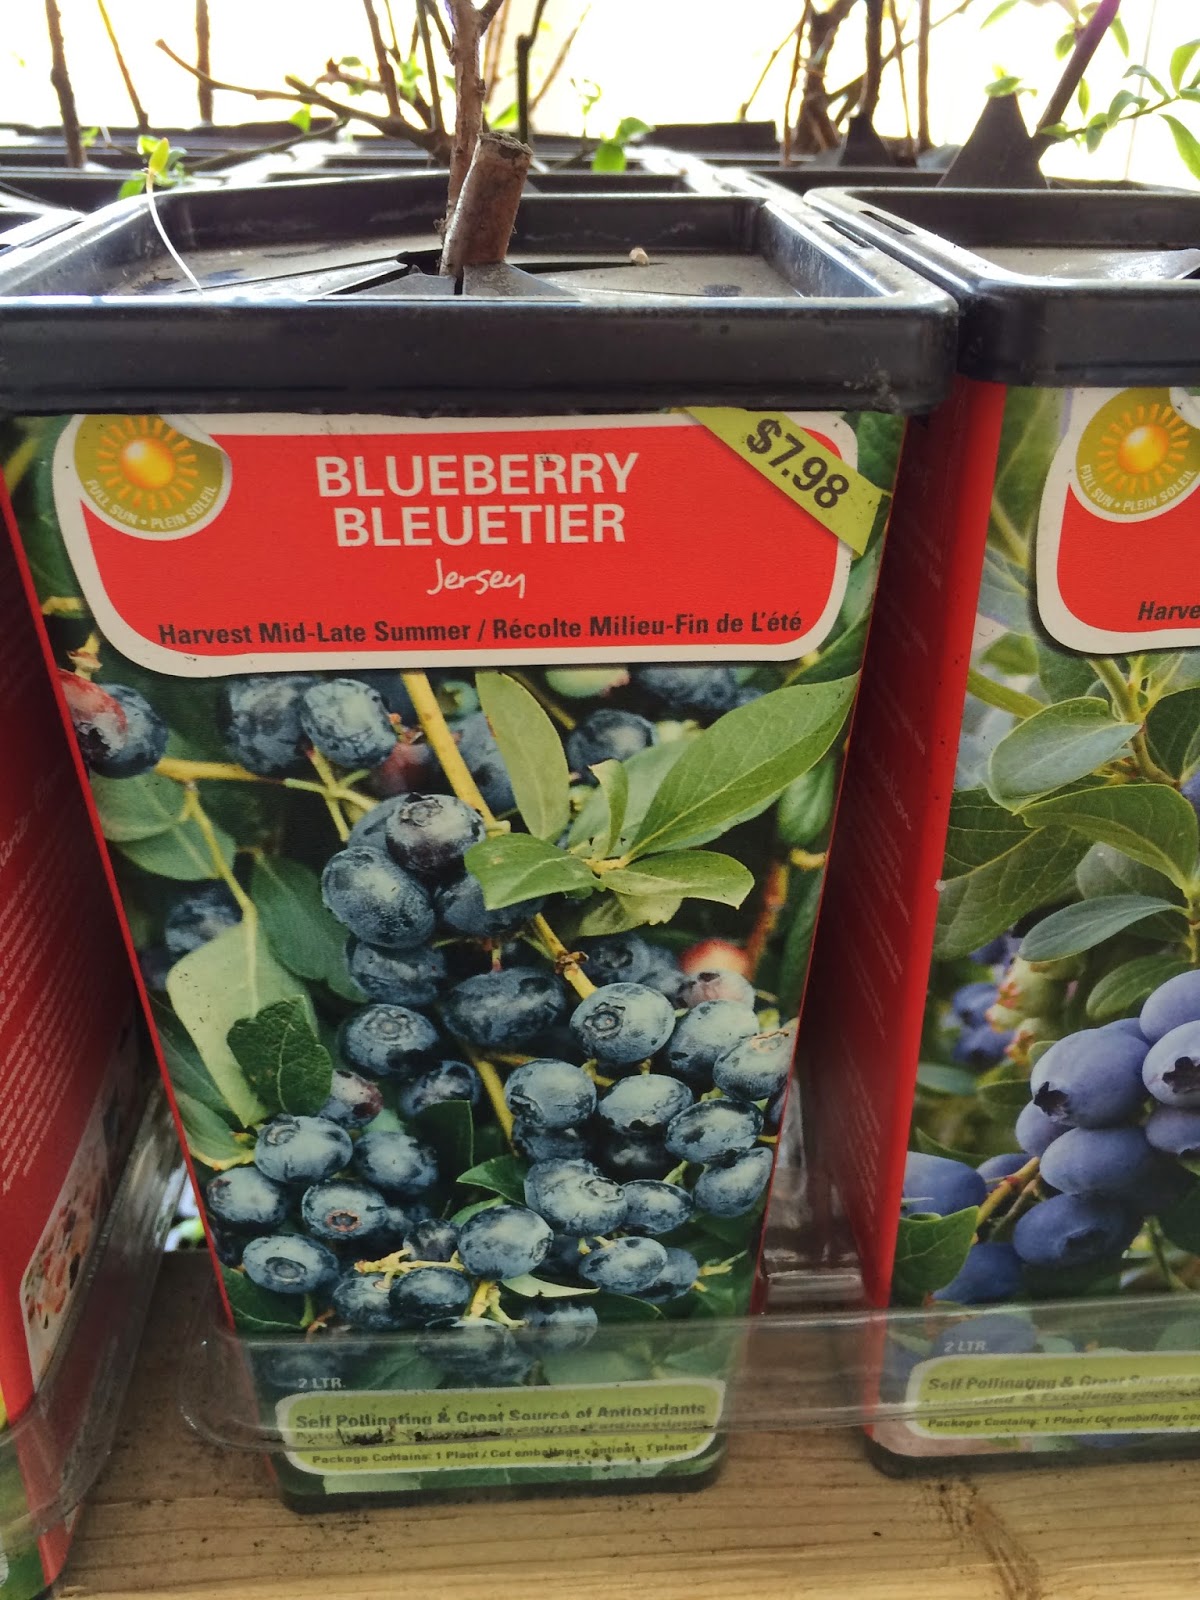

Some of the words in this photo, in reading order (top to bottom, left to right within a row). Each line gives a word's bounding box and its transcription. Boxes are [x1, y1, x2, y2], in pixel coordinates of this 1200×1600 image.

[315, 452, 639, 498] BLUEBERRY
[745, 417, 850, 509] $7.98
[85, 479, 110, 507] FULL
[109, 504, 138, 525] SUN
[150, 514, 188, 530] PLEIN
[186, 485, 218, 520] SOLEIL
[1091, 487, 1114, 508] SUN
[1122, 495, 1158, 512] PLEIN
[1159, 470, 1197, 502] SOLEIL
[333, 503, 626, 548] BLEUETIER
[426, 558, 527, 599] Jersey
[158, 622, 251, 645] Harvest
[258, 621, 366, 644] Mid-Late
[374, 621, 471, 643] Summer
[476, 619, 486, 642] /
[493, 617, 582, 640] Récolte
[590, 613, 709, 637] Milieu-Fin
[716, 612, 744, 634] de
[751, 611, 802, 633] L'été
[944, 1341, 955, 1353] 2
[298, 1378, 308, 1389] 2
[296, 1413, 332, 1430] Self
[335, 1411, 433, 1429] Pollinating
[437, 1409, 451, 1424] &
[456, 1410, 505, 1425] Great
[508, 1407, 571, 1422] Source
[575, 1406, 594, 1419] of
[595, 1403, 707, 1419] Antioxidants
[312, 1455, 369, 1465] Package
[446, 1450, 480, 1460] Plant
[655, 1442, 689, 1454] plant
